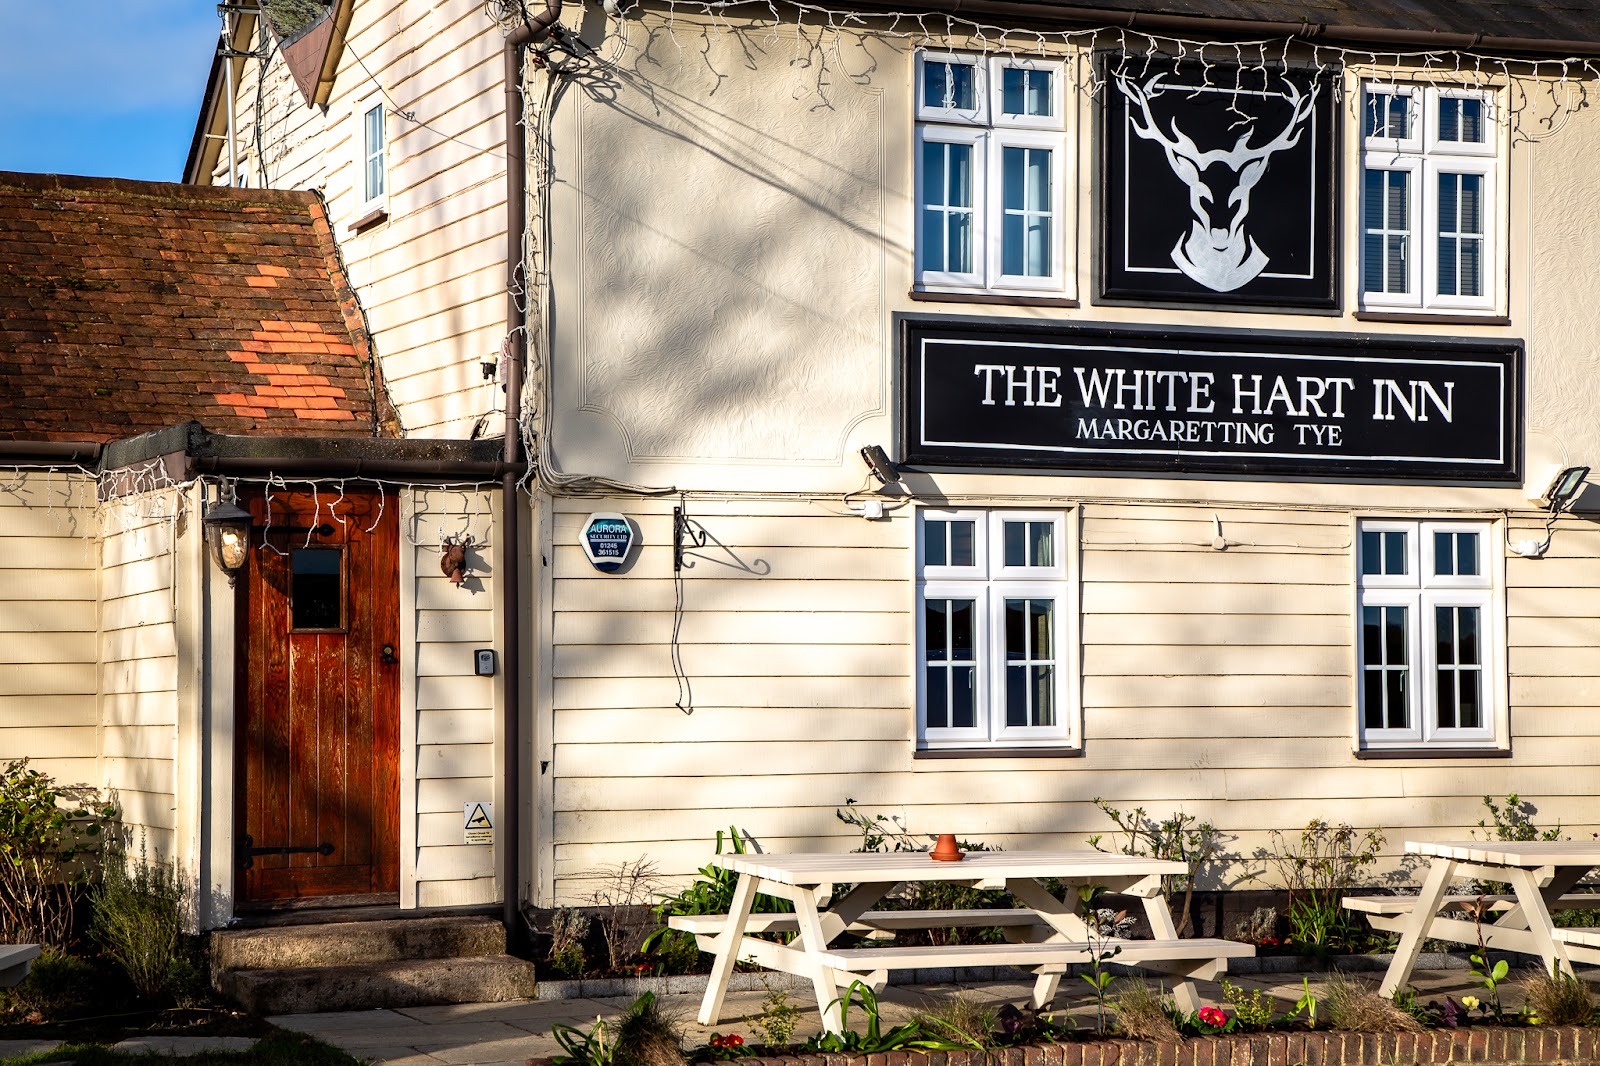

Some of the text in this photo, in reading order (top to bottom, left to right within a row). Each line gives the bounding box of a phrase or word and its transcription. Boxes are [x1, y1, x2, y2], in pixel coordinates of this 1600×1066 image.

[974, 364, 1455, 423] THE WHITE HART INN
[1075, 417, 1343, 447] MARGARETTING TYE
[590, 524, 627, 533] AURORA
